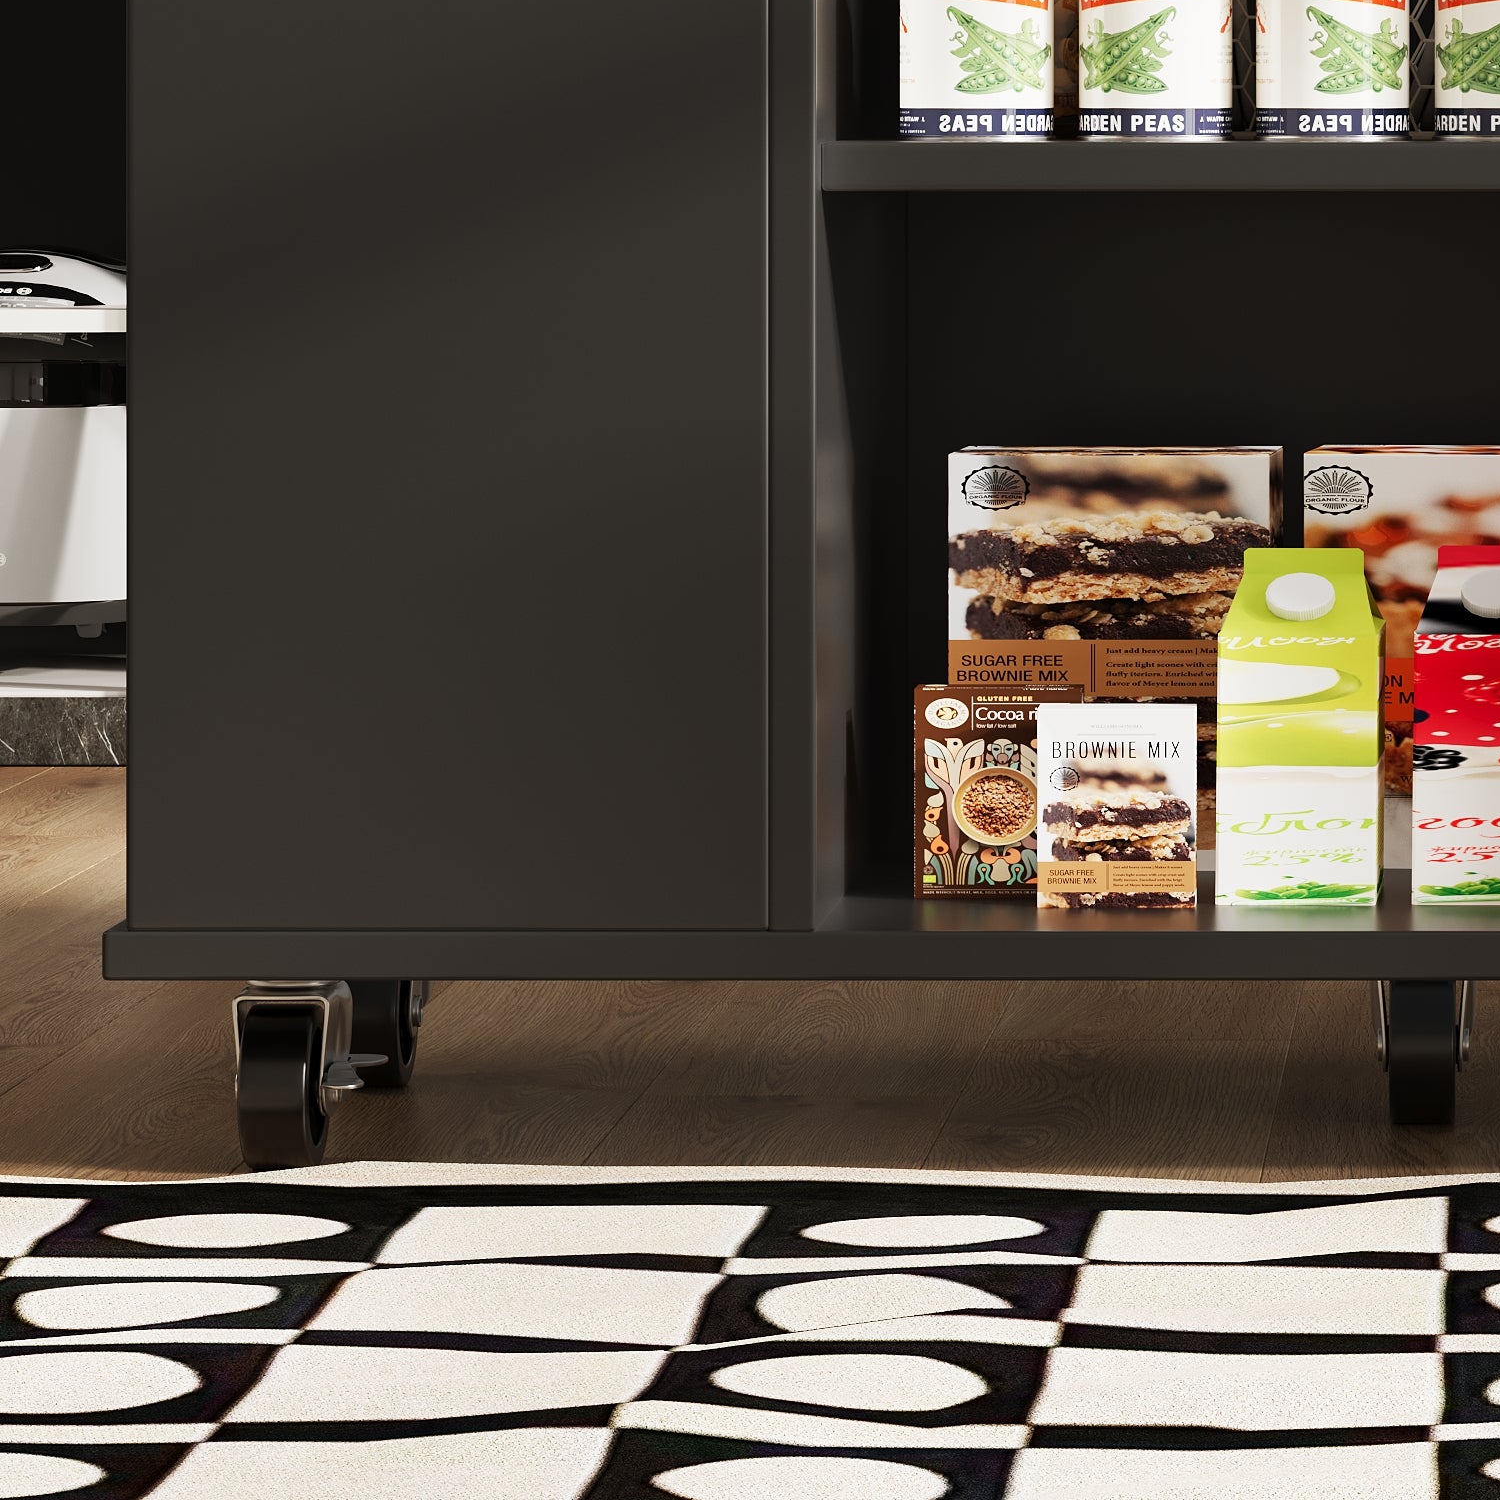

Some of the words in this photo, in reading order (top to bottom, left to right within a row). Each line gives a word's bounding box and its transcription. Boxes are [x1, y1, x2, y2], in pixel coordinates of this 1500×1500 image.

[1131, 114, 1185, 132] PEAS
[1434, 114, 1481, 132] ARDEN
[1142, 647, 1165, 655] heavy
[961, 654, 1017, 667] SUGAR
[1022, 654, 1063, 667] FREE
[1135, 661, 1155, 669] light
[957, 670, 1033, 682] BROWNIE
[1039, 670, 1069, 682] MIX
[1143, 680, 1168, 688] Meyer
[975, 706, 1025, 721] Cocoa
[1052, 741, 1137, 759] BROWNIE
[1148, 741, 1180, 759] MIX
[1049, 869, 1074, 877] SUGAR
[1076, 869, 1095, 877] FREE
[1047, 877, 1081, 885] BROWNIE
[1083, 877, 1097, 885] MIX
